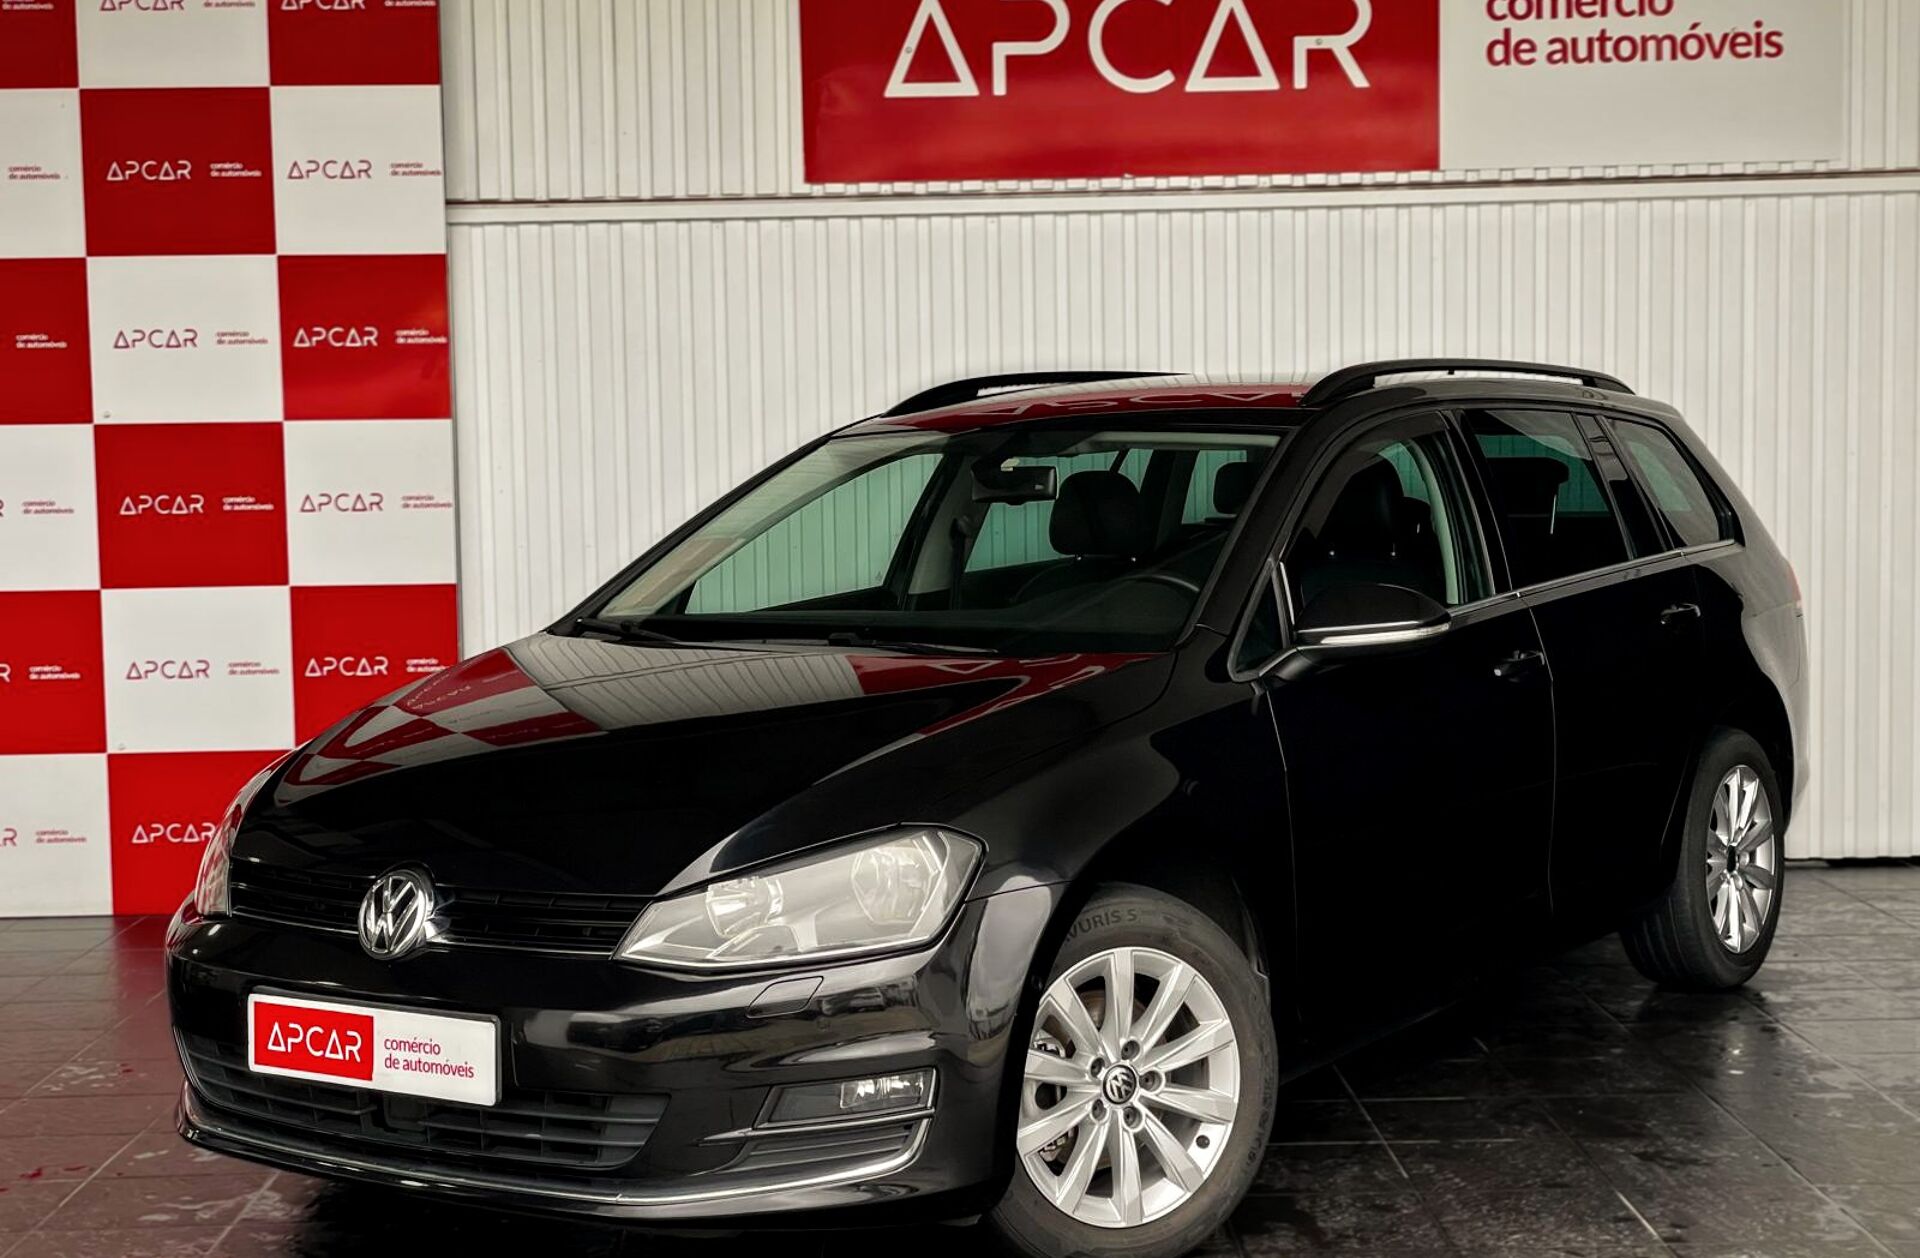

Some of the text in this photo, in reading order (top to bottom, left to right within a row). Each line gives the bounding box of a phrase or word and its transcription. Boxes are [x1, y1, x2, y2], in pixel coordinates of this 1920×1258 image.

[885, 0, 1372, 98] APCAR
[1486, 20, 1784, 66] de automóveis
[106, 161, 192, 181] APCAR
[287, 160, 372, 180] APCAR
[113, 329, 198, 350] APCAR
[293, 326, 378, 347] APCAR
[120, 495, 205, 515] APCAR
[300, 493, 384, 513] APCAR
[126, 660, 210, 680] APCAR
[304, 656, 389, 677] APCAR
[267, 1021, 363, 1063] APCAR
[384, 1037, 441, 1056] comércio
[384, 1054, 475, 1079] de automóveis
